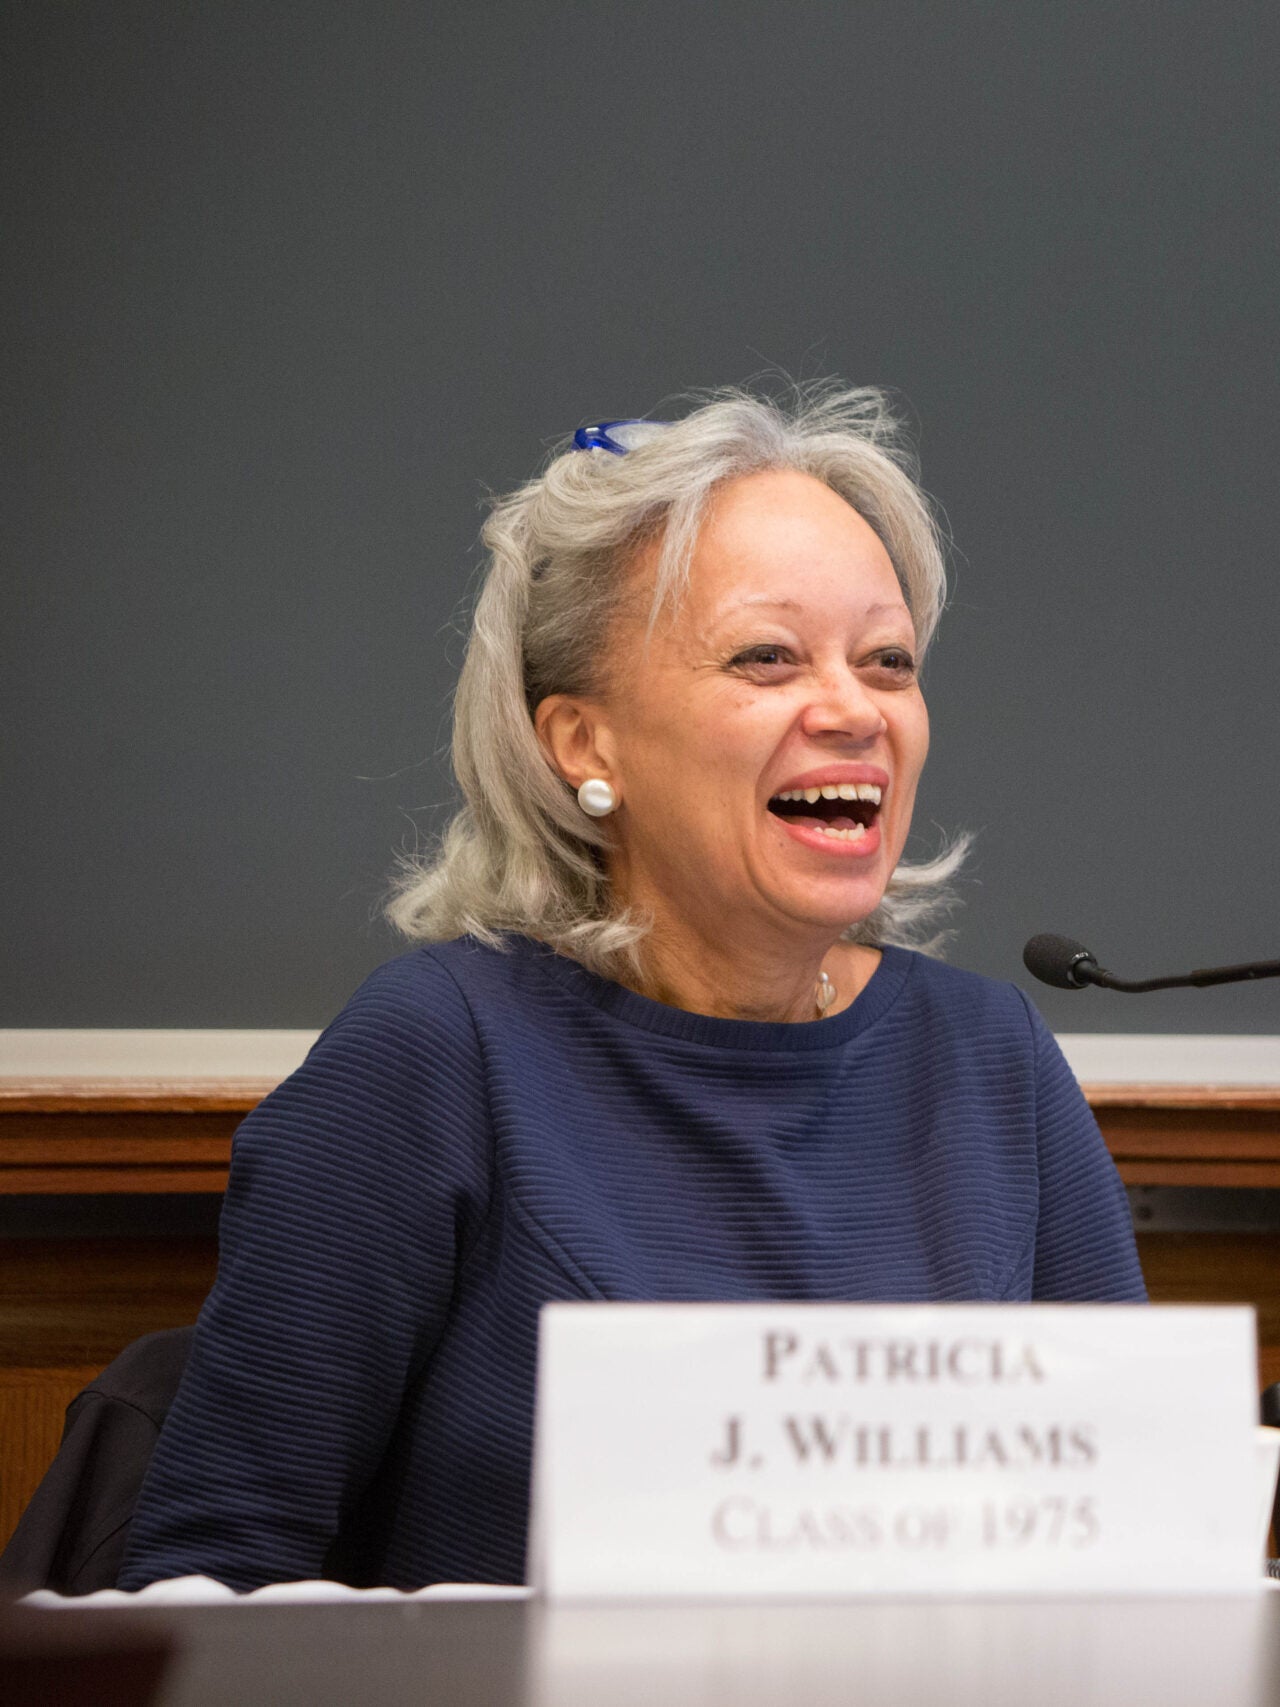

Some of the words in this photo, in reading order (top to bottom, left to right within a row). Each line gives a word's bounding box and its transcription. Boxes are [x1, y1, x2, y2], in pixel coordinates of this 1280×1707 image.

[760, 1327, 1045, 1385] PATRICIA
[710, 1413, 763, 1470] J.
[782, 1413, 1099, 1470] WILLIAMS
[710, 1496, 883, 1551] CLASS
[892, 1509, 954, 1551] OF
[982, 1494, 1101, 1550] 1975
